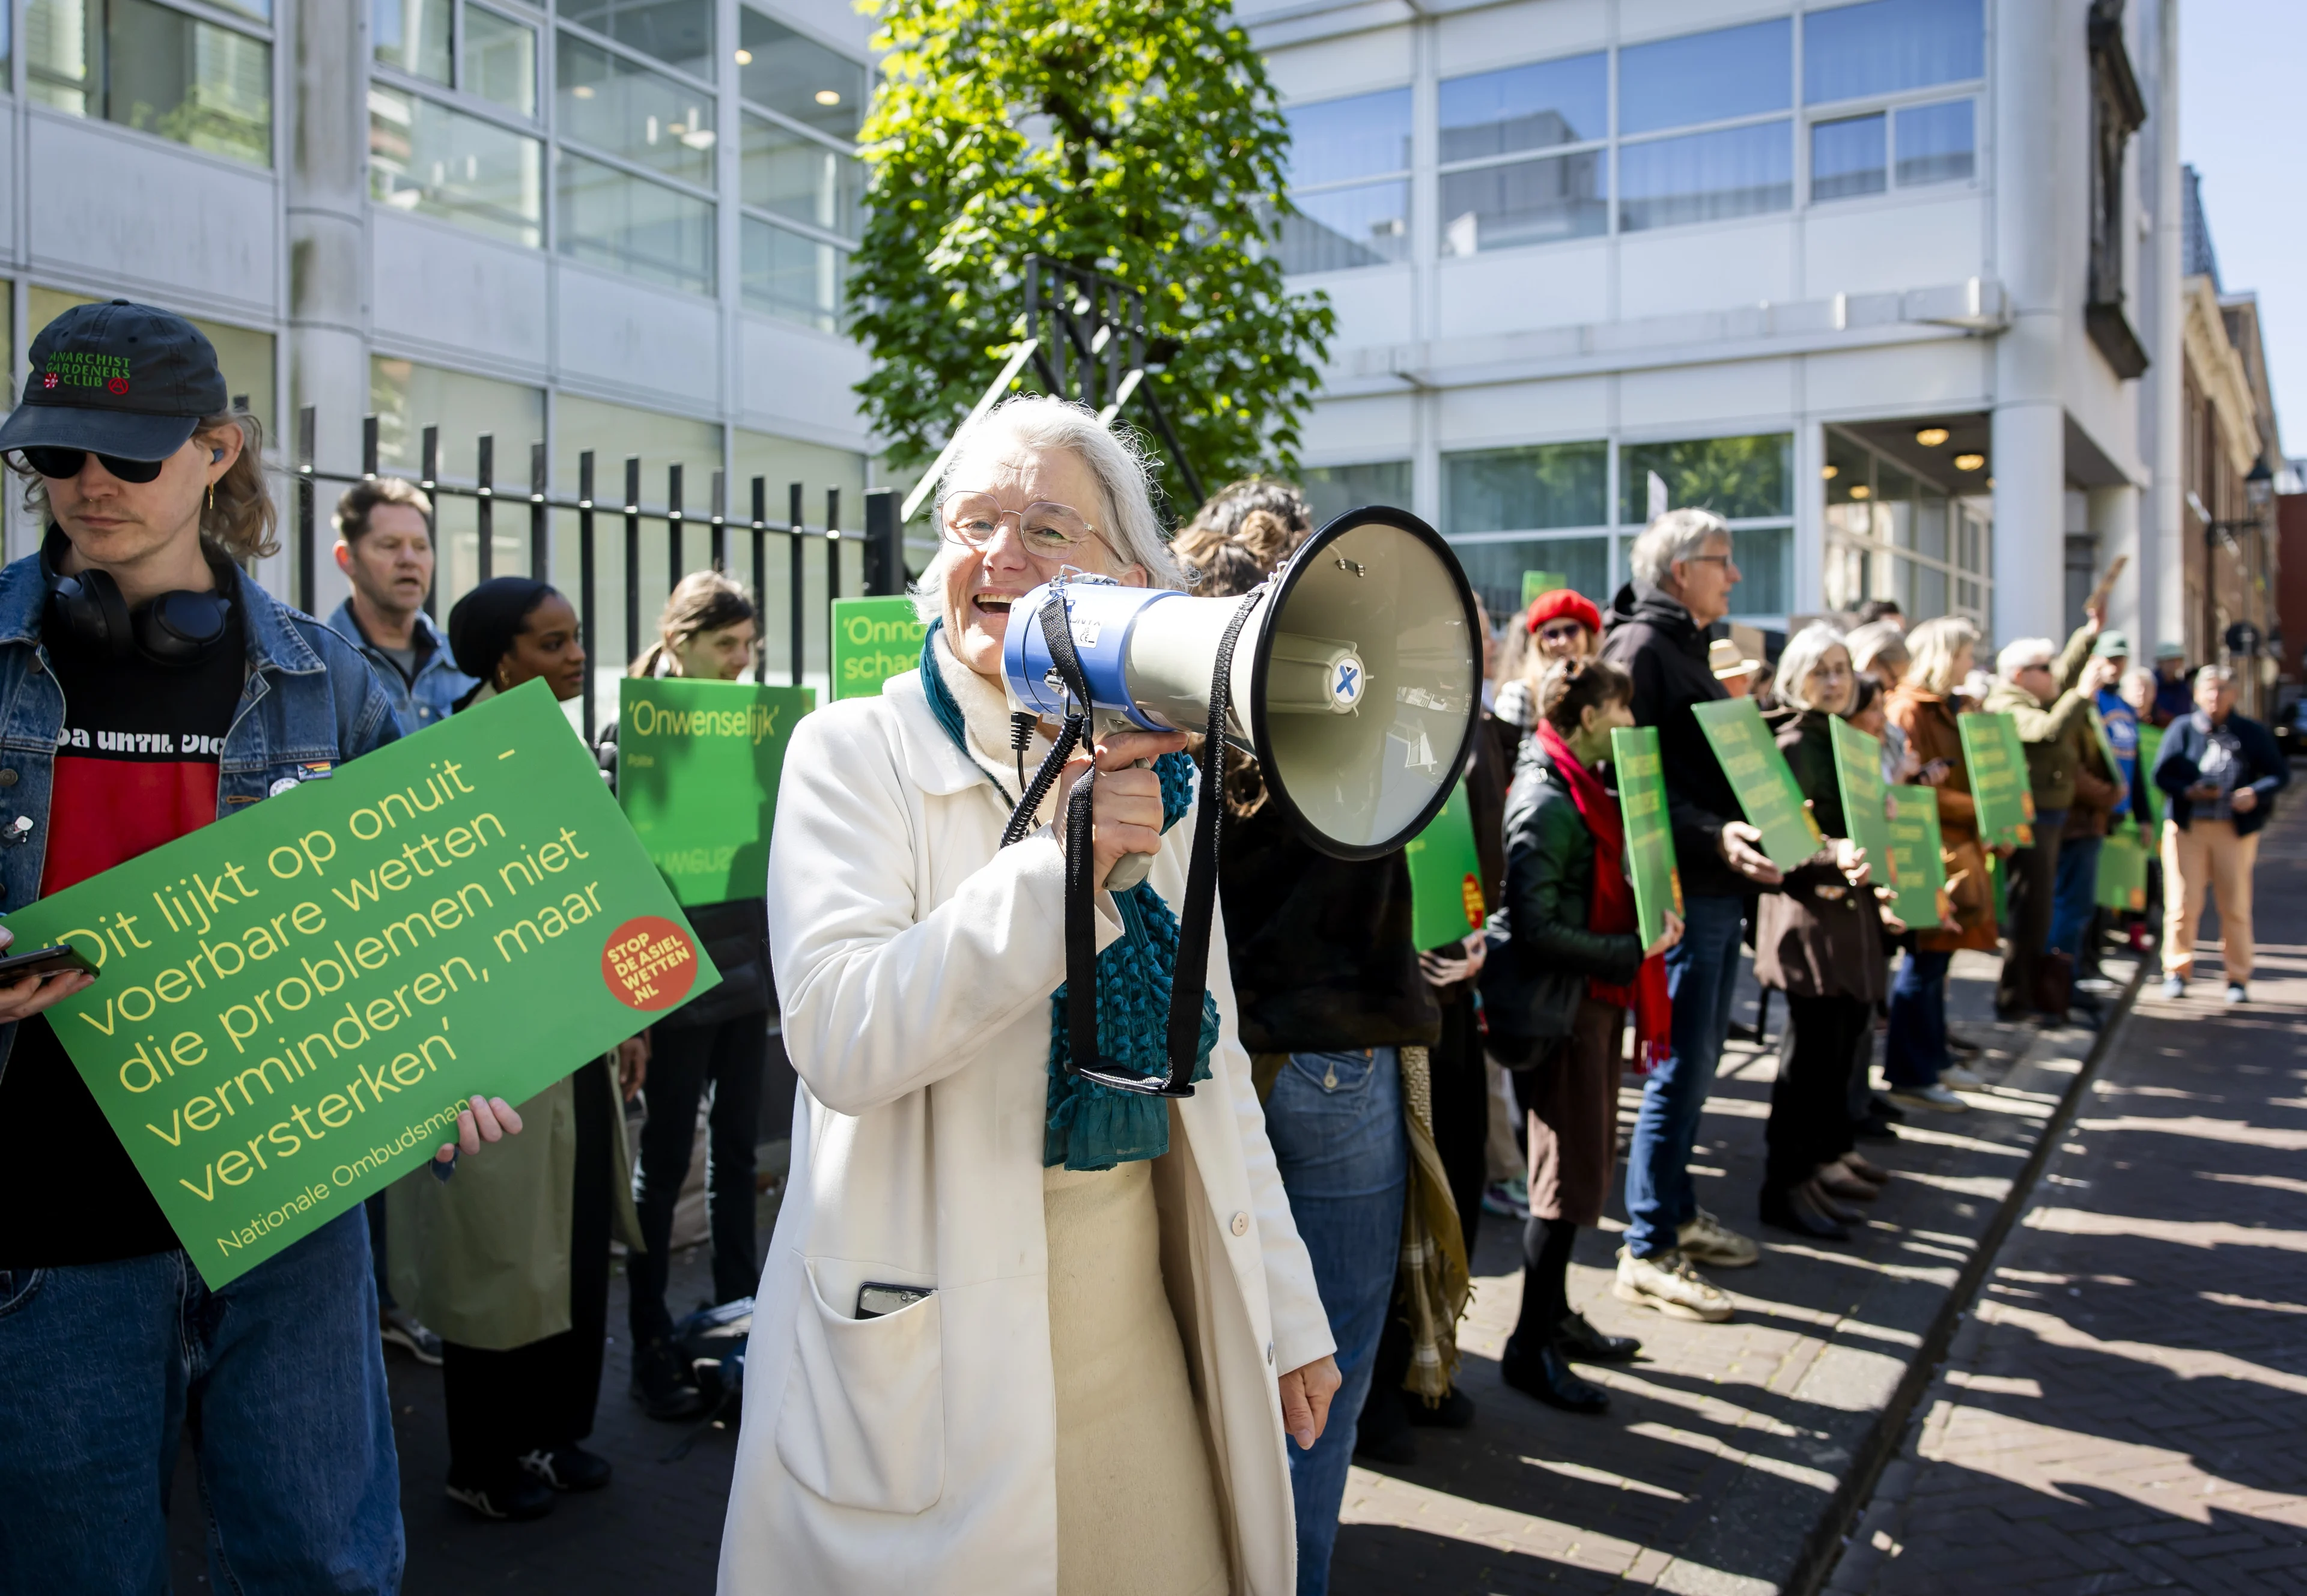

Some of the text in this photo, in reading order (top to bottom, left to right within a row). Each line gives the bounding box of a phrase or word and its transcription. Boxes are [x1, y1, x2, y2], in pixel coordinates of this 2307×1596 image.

[46, 362, 131, 379] GARDENERS
[49, 351, 130, 368] ANARCHIST
[63, 374, 103, 387] CLUB
[153, 861, 259, 936] lijkt
[267, 830, 336, 879] op
[349, 759, 475, 840] onuit
[78, 813, 506, 1036] voerbare wetten
[120, 1031, 208, 1093] die
[218, 883, 493, 1054] problemen
[498, 827, 589, 896] niet
[607, 932, 649, 963] STOP
[614, 934, 683, 978] DE ASIEL
[621, 946, 690, 991] WETTEN
[146, 881, 602, 1147] verminderen, maar
[633, 983, 660, 1006] .NL
[179, 1016, 457, 1202] versterken'
[216, 1099, 470, 1257] Nationale Ombudsman
